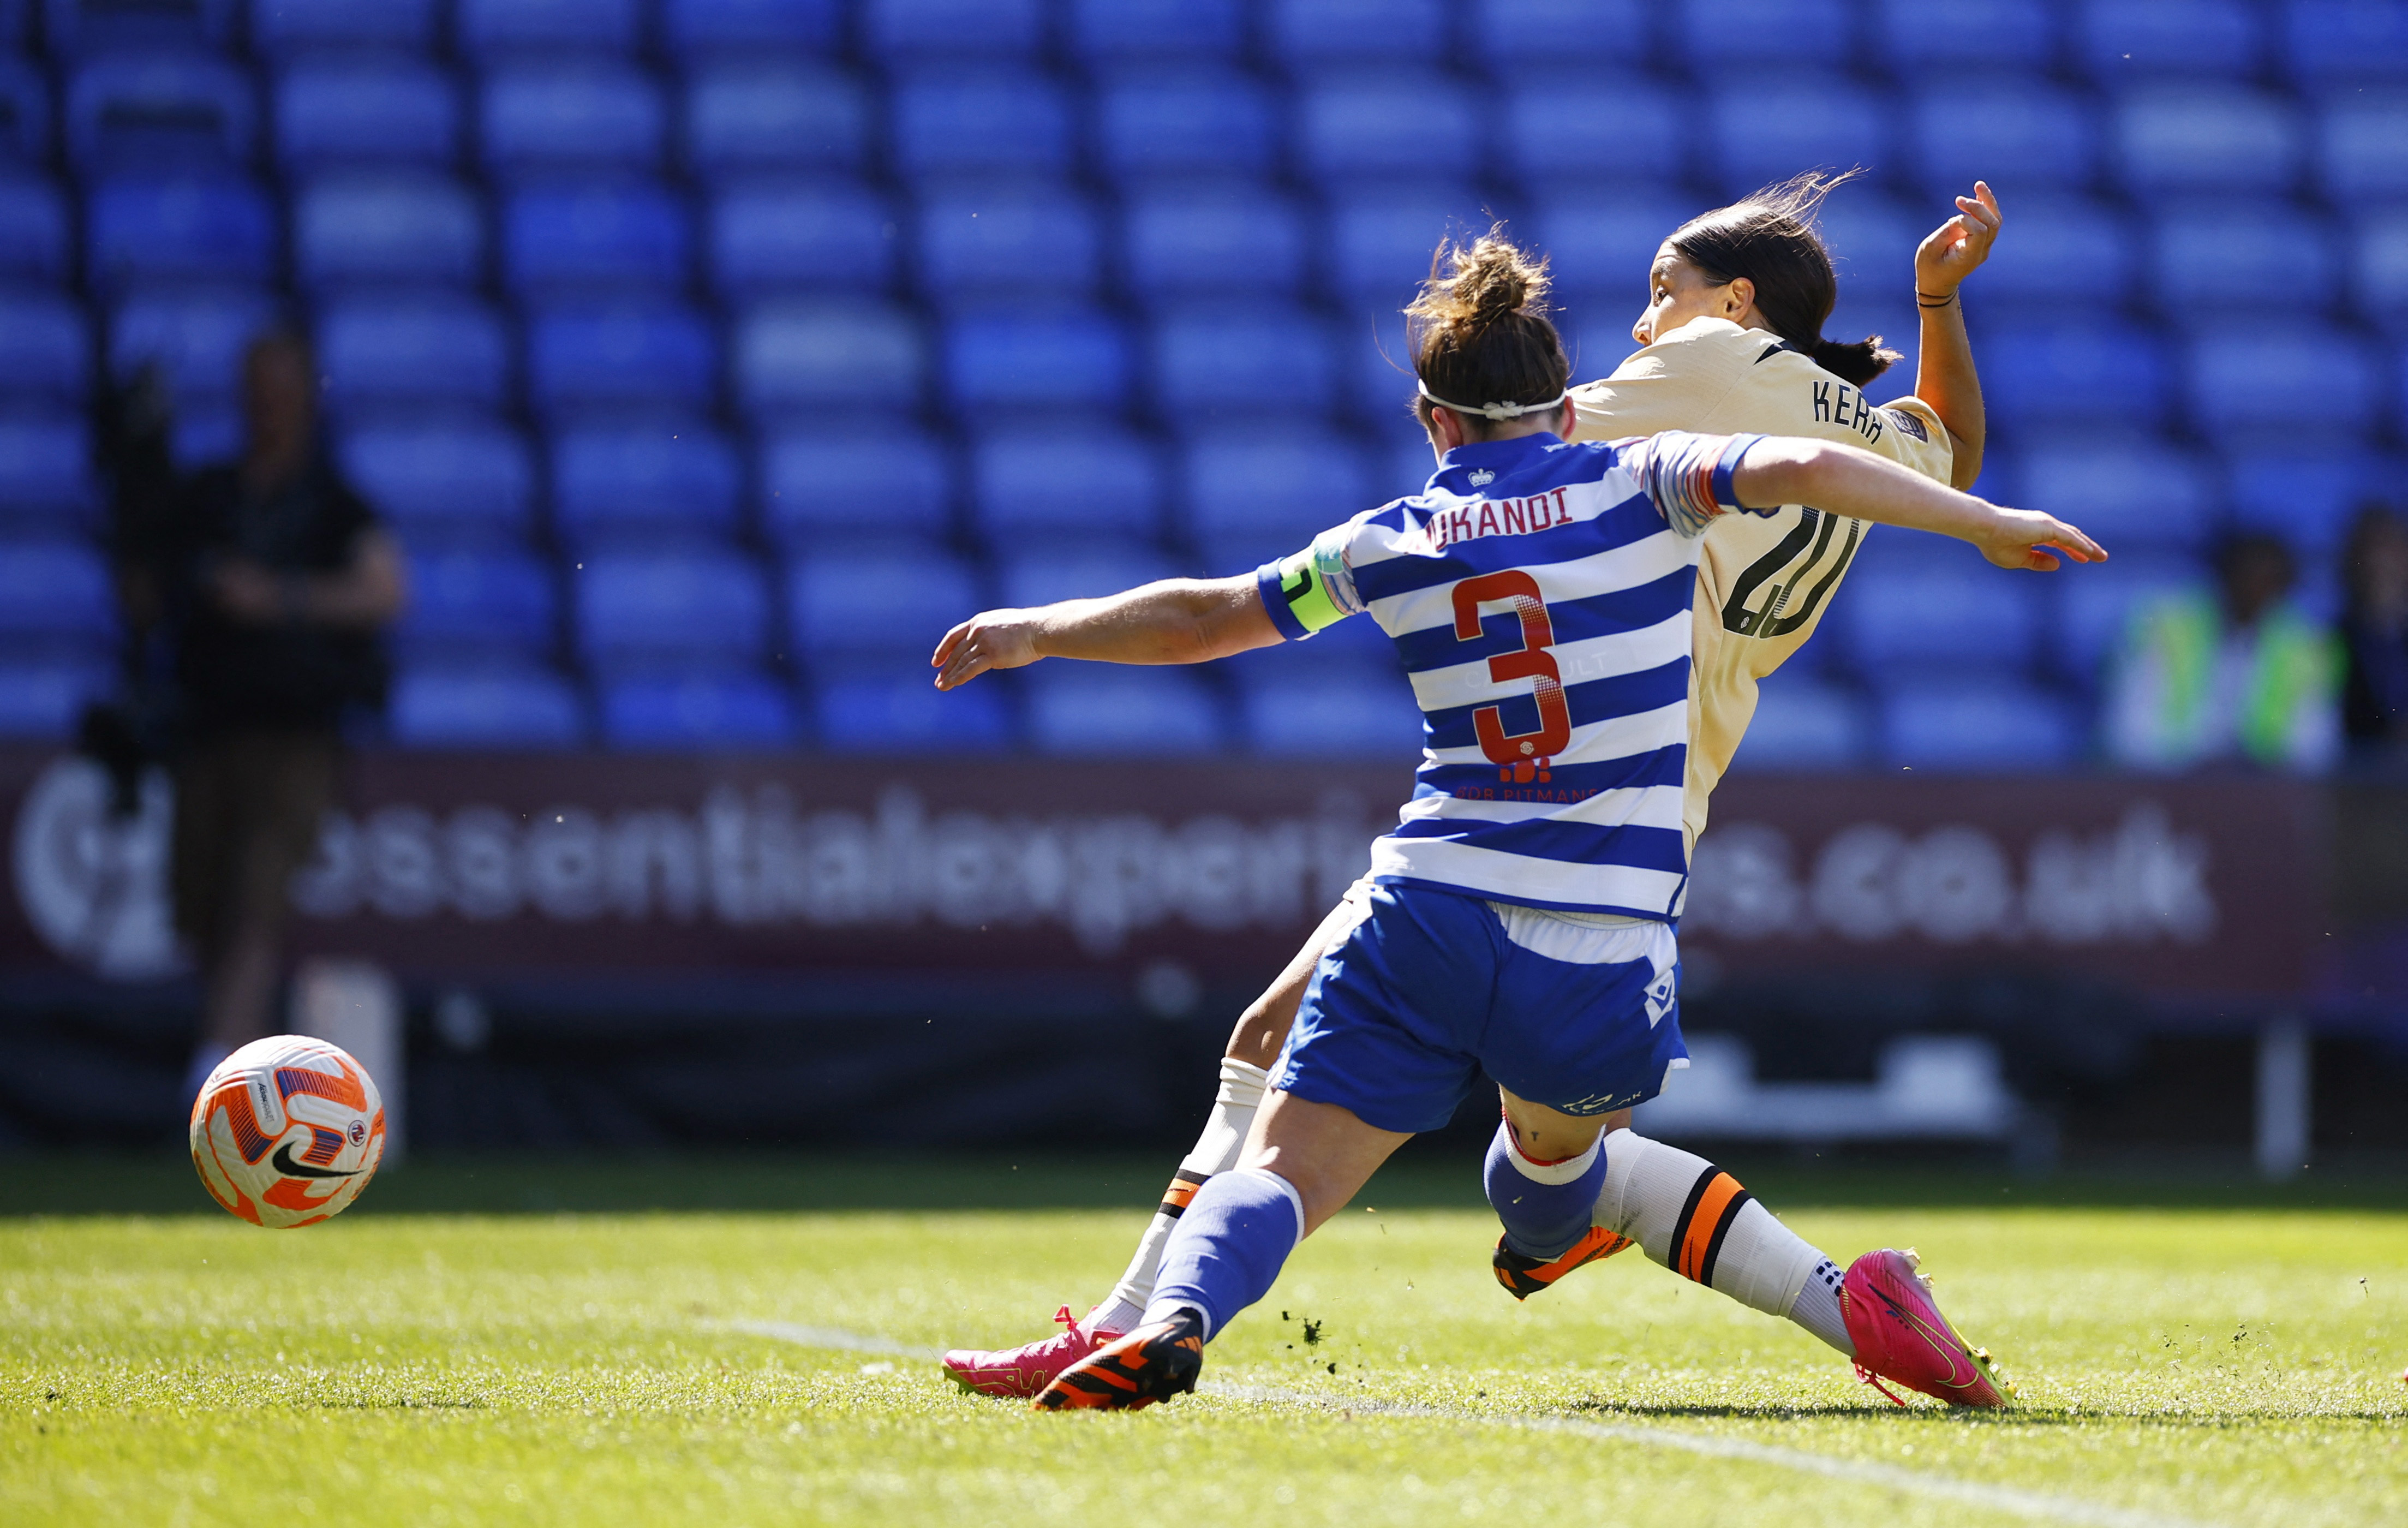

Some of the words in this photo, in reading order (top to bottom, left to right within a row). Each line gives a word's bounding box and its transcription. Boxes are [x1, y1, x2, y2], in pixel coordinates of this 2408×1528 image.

[1812, 380, 1883, 445] KERR
[1425, 486, 1573, 552] UKANDI
[1721, 505, 1860, 639] 20
[1451, 570, 1572, 765] 3
